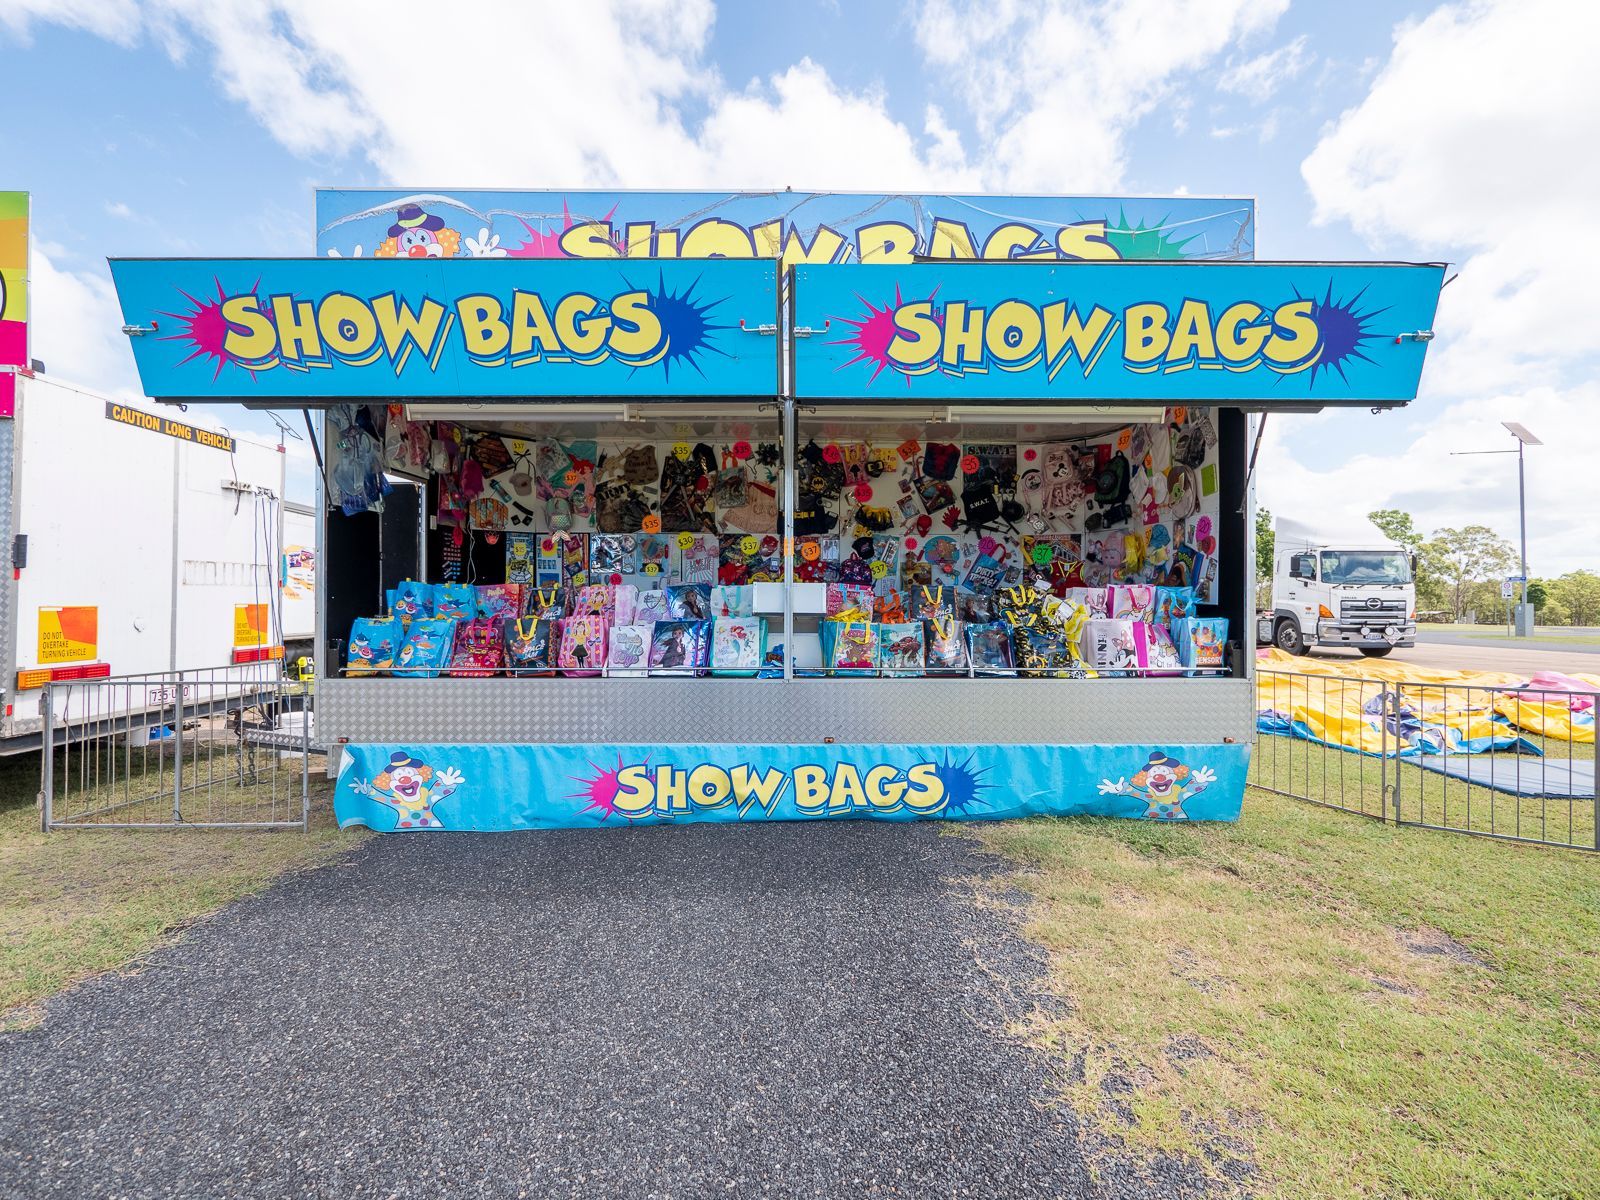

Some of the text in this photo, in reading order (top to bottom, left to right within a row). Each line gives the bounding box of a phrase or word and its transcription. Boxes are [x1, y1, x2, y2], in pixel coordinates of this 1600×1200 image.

[221, 289, 669, 376] SHOW BAGS
[886, 297, 1324, 383] SHOW BAGS
[112, 405, 232, 451] CAUTION LONG VEHICLE
[1118, 434, 1130, 445] $37
[673, 446, 689, 456] $35
[643, 519, 660, 529] $35
[677, 535, 694, 547] $30
[743, 541, 758, 551] $37
[803, 545, 818, 556] $37
[975, 566, 995, 578] DIRTY
[43, 631, 63, 640] DO NOT
[42, 640, 69, 650] OVERTAKE
[522, 639, 546, 653] SPACE
[42, 647, 87, 659] TURNING VEHICLE
[612, 762, 949, 819] SHOW BAGS
